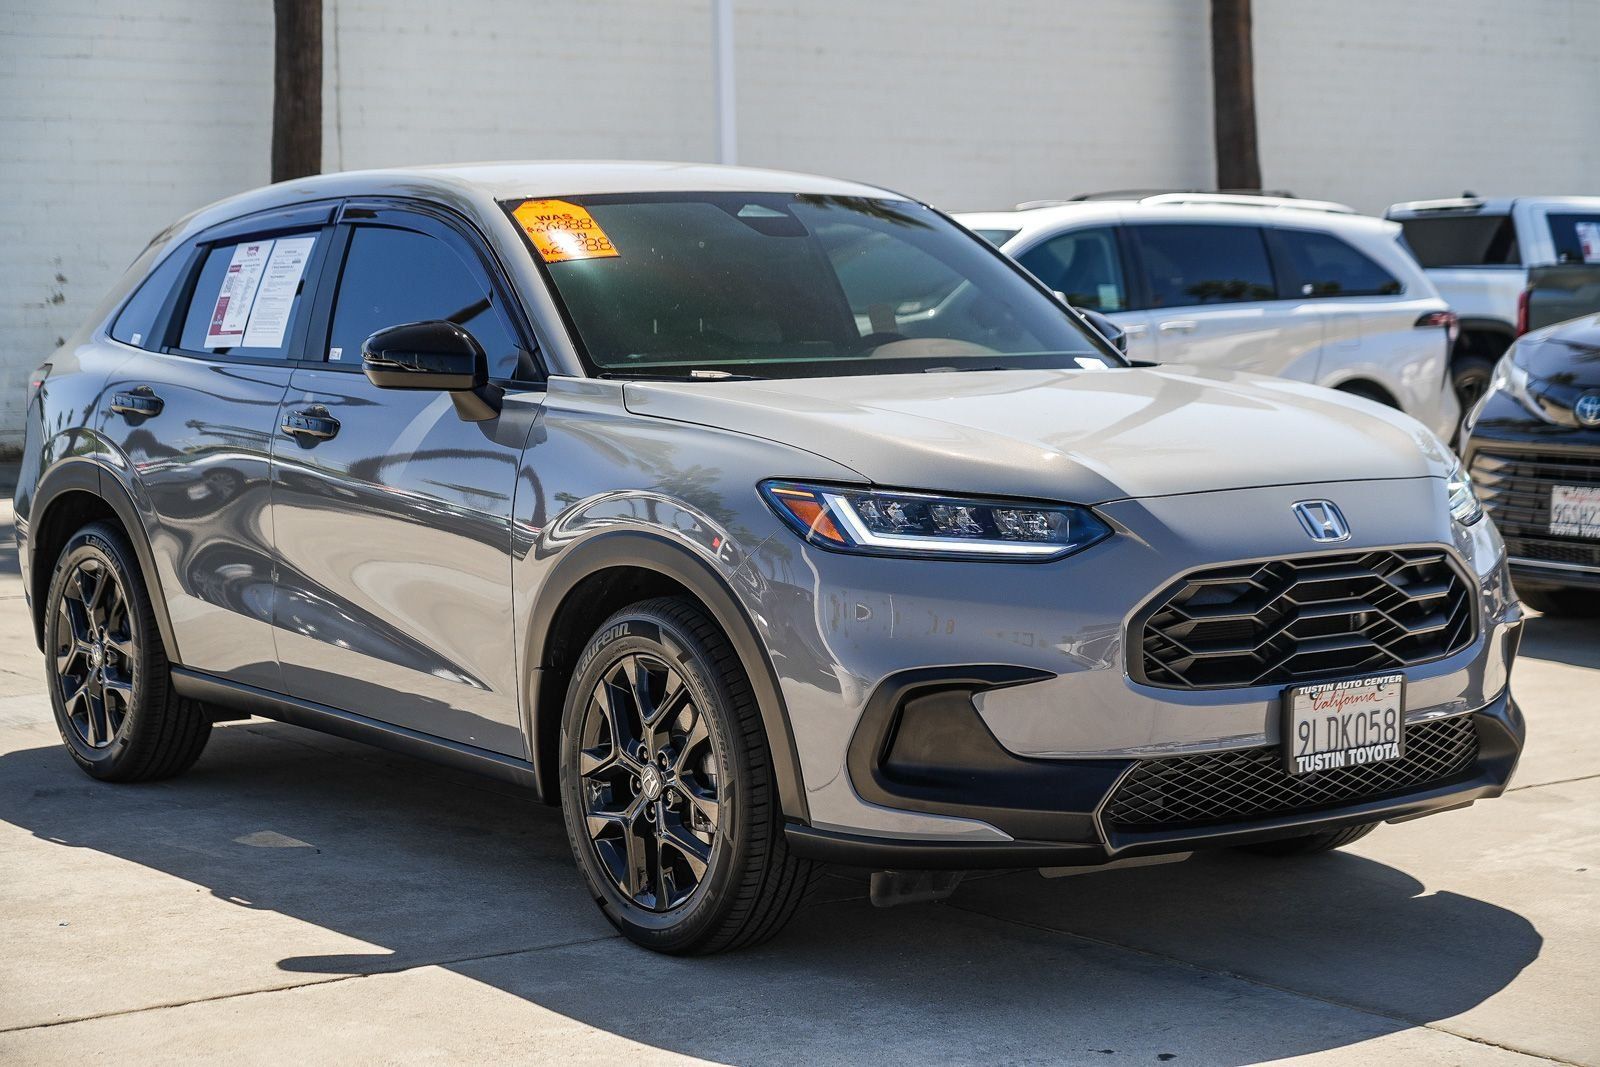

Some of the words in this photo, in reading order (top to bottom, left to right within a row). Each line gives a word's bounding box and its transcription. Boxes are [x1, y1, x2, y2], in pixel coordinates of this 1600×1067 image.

[535, 213, 573, 221] WAS
[1299, 683, 1334, 695] TUSTIN
[1335, 679, 1362, 690] AUTO
[1364, 675, 1403, 687] CENTER
[1313, 689, 1383, 713] California
[1296, 750, 1346, 773] TUSTIN
[1348, 742, 1400, 766] TOYOTA
